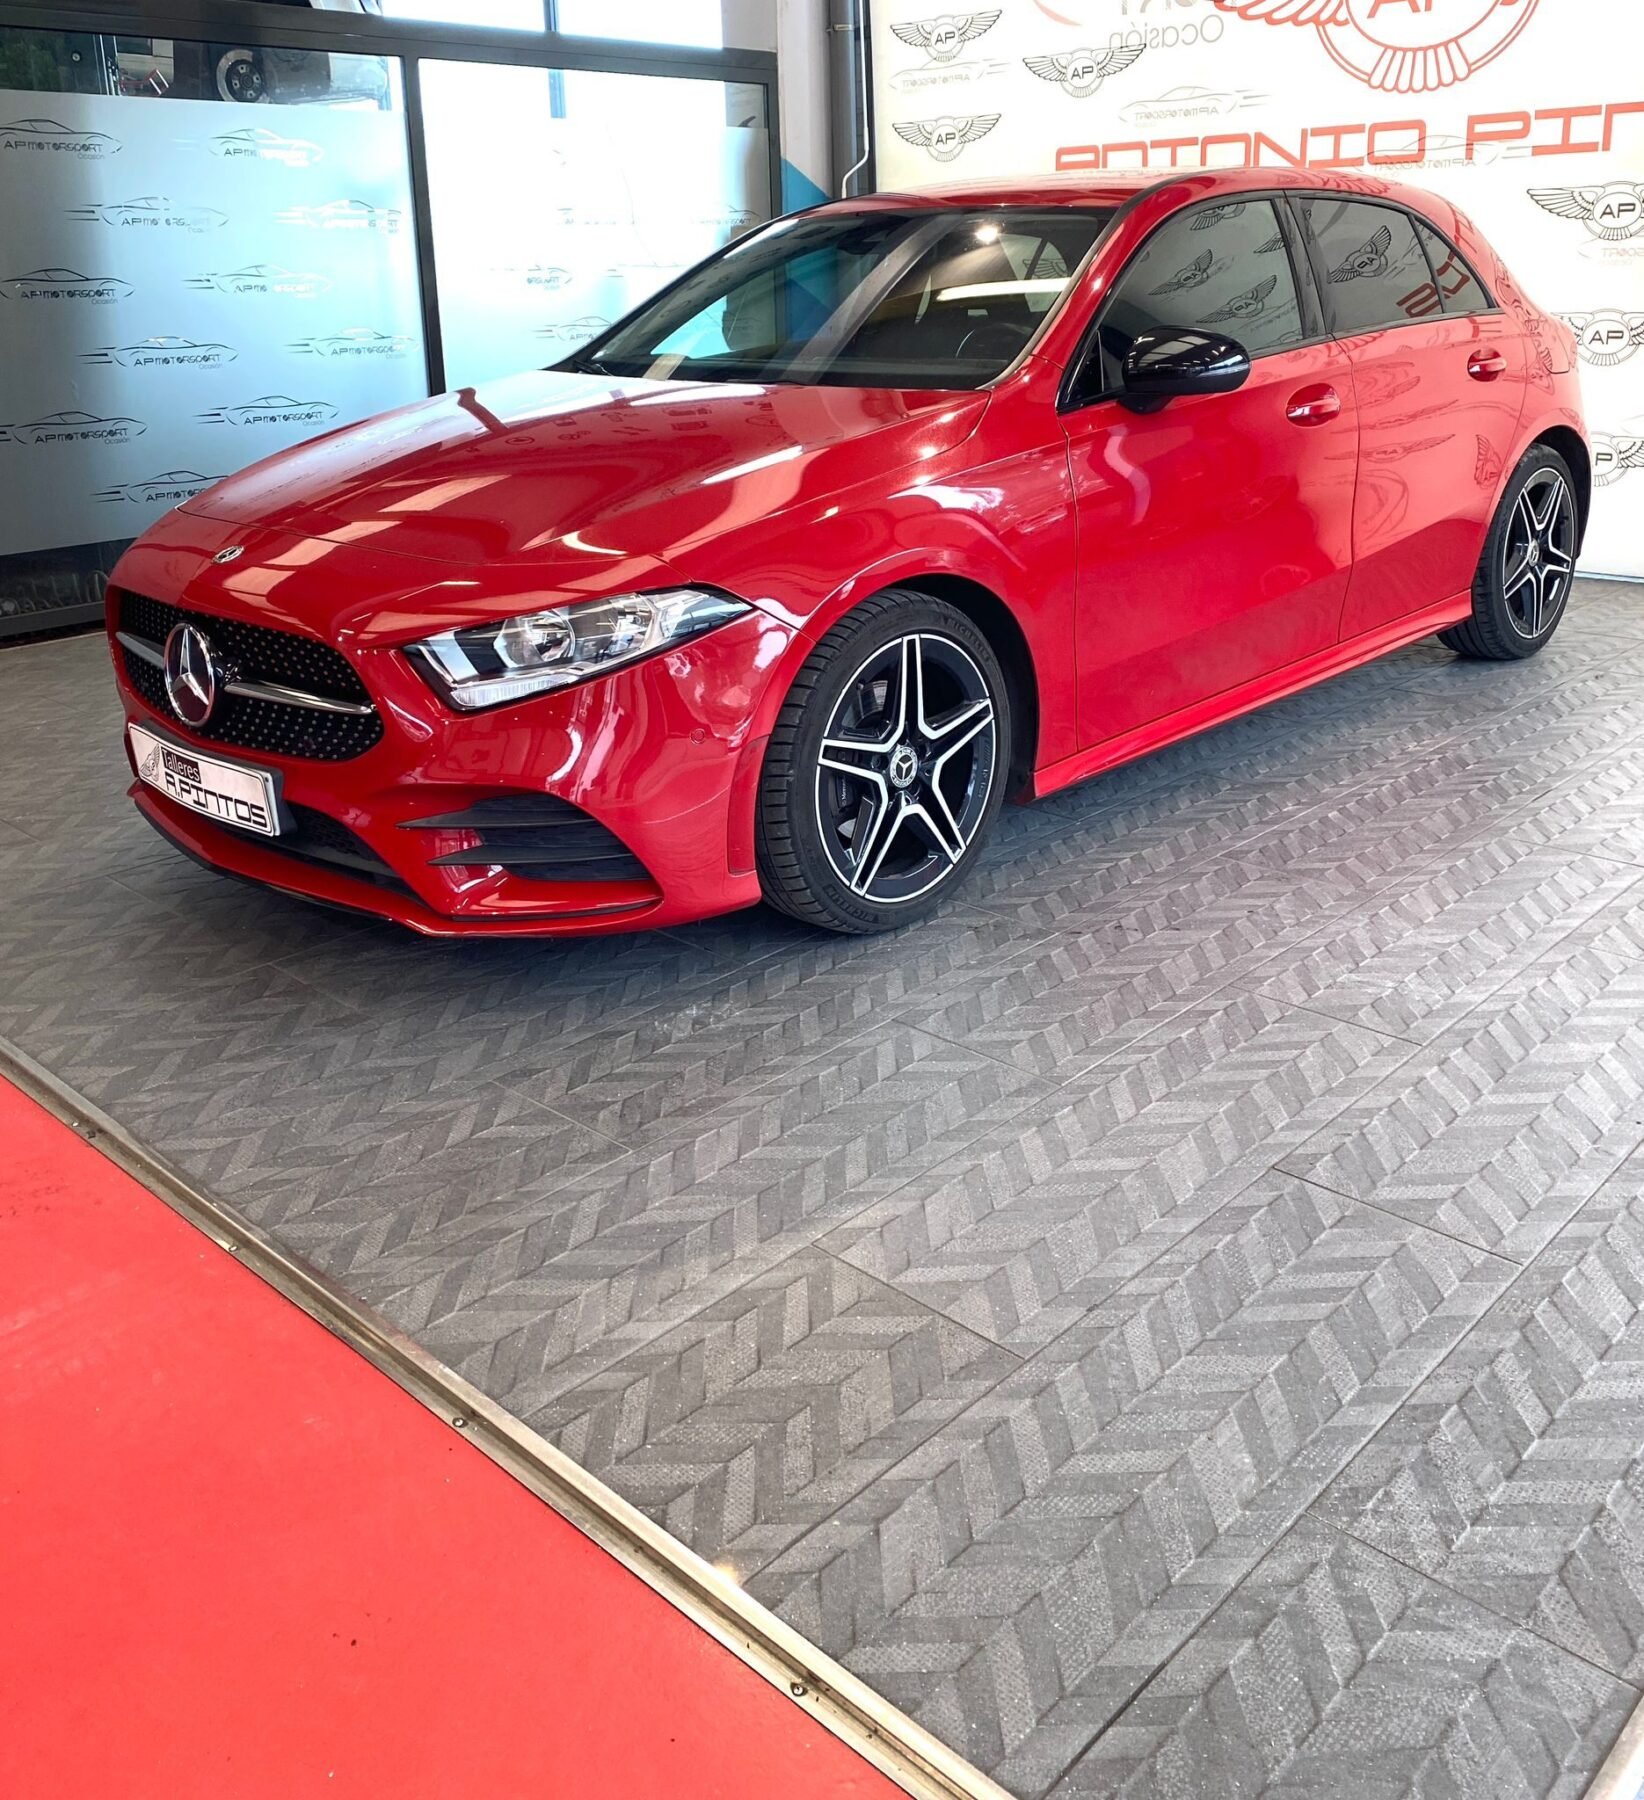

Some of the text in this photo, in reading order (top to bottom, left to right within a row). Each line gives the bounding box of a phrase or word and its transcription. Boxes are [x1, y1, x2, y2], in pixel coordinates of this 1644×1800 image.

[934, 31, 956, 46] AP
[1071, 65, 1094, 80] AP
[935, 132, 957, 145] AP
[1599, 203, 1636, 219] AP
[1589, 330, 1625, 345] AP
[162, 747, 200, 781] Talleres
